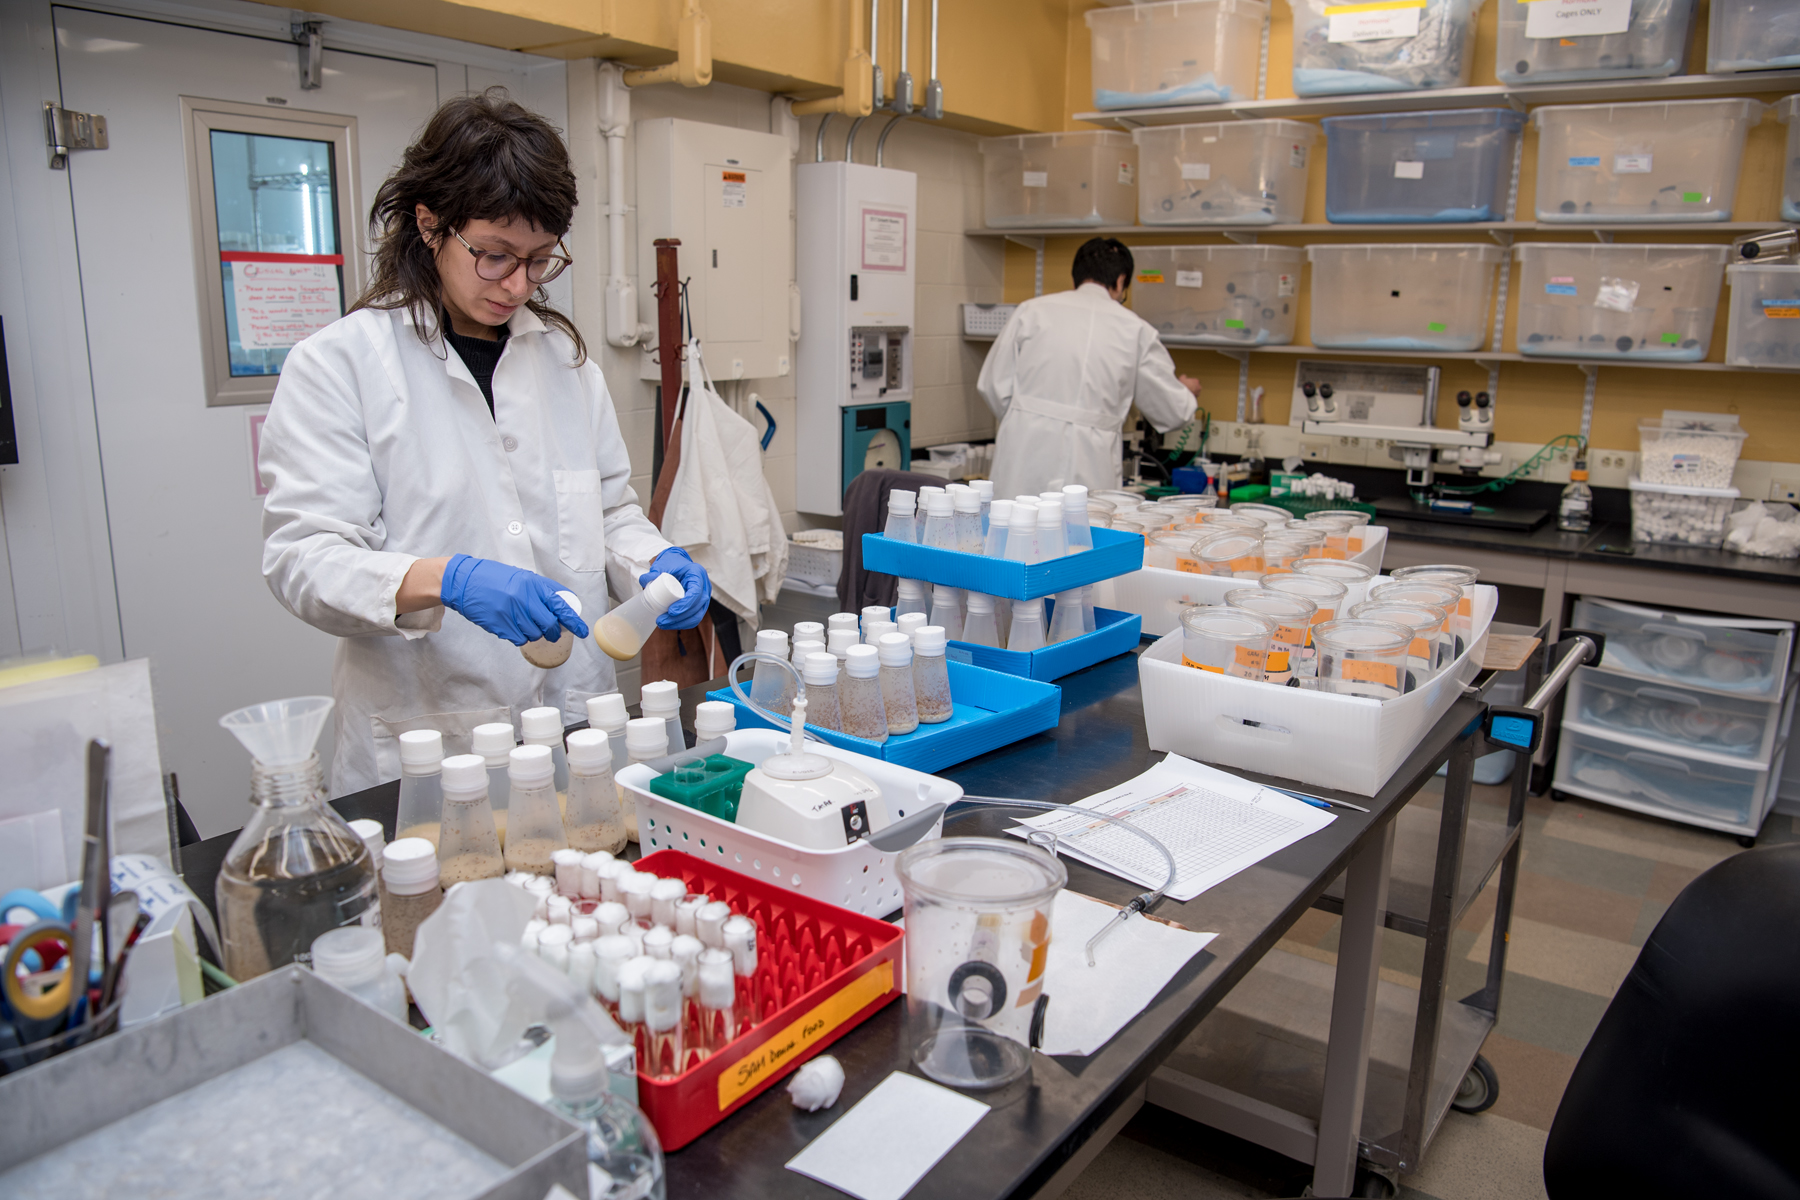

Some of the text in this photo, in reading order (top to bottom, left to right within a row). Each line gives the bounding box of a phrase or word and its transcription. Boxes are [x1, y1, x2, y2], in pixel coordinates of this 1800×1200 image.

[1556, 7, 1602, 19] Cages ONLY
[242, 263, 285, 278] CRITICAL
[1243, 670, 1253, 678] 20
[736, 1054, 766, 1087] SAM
